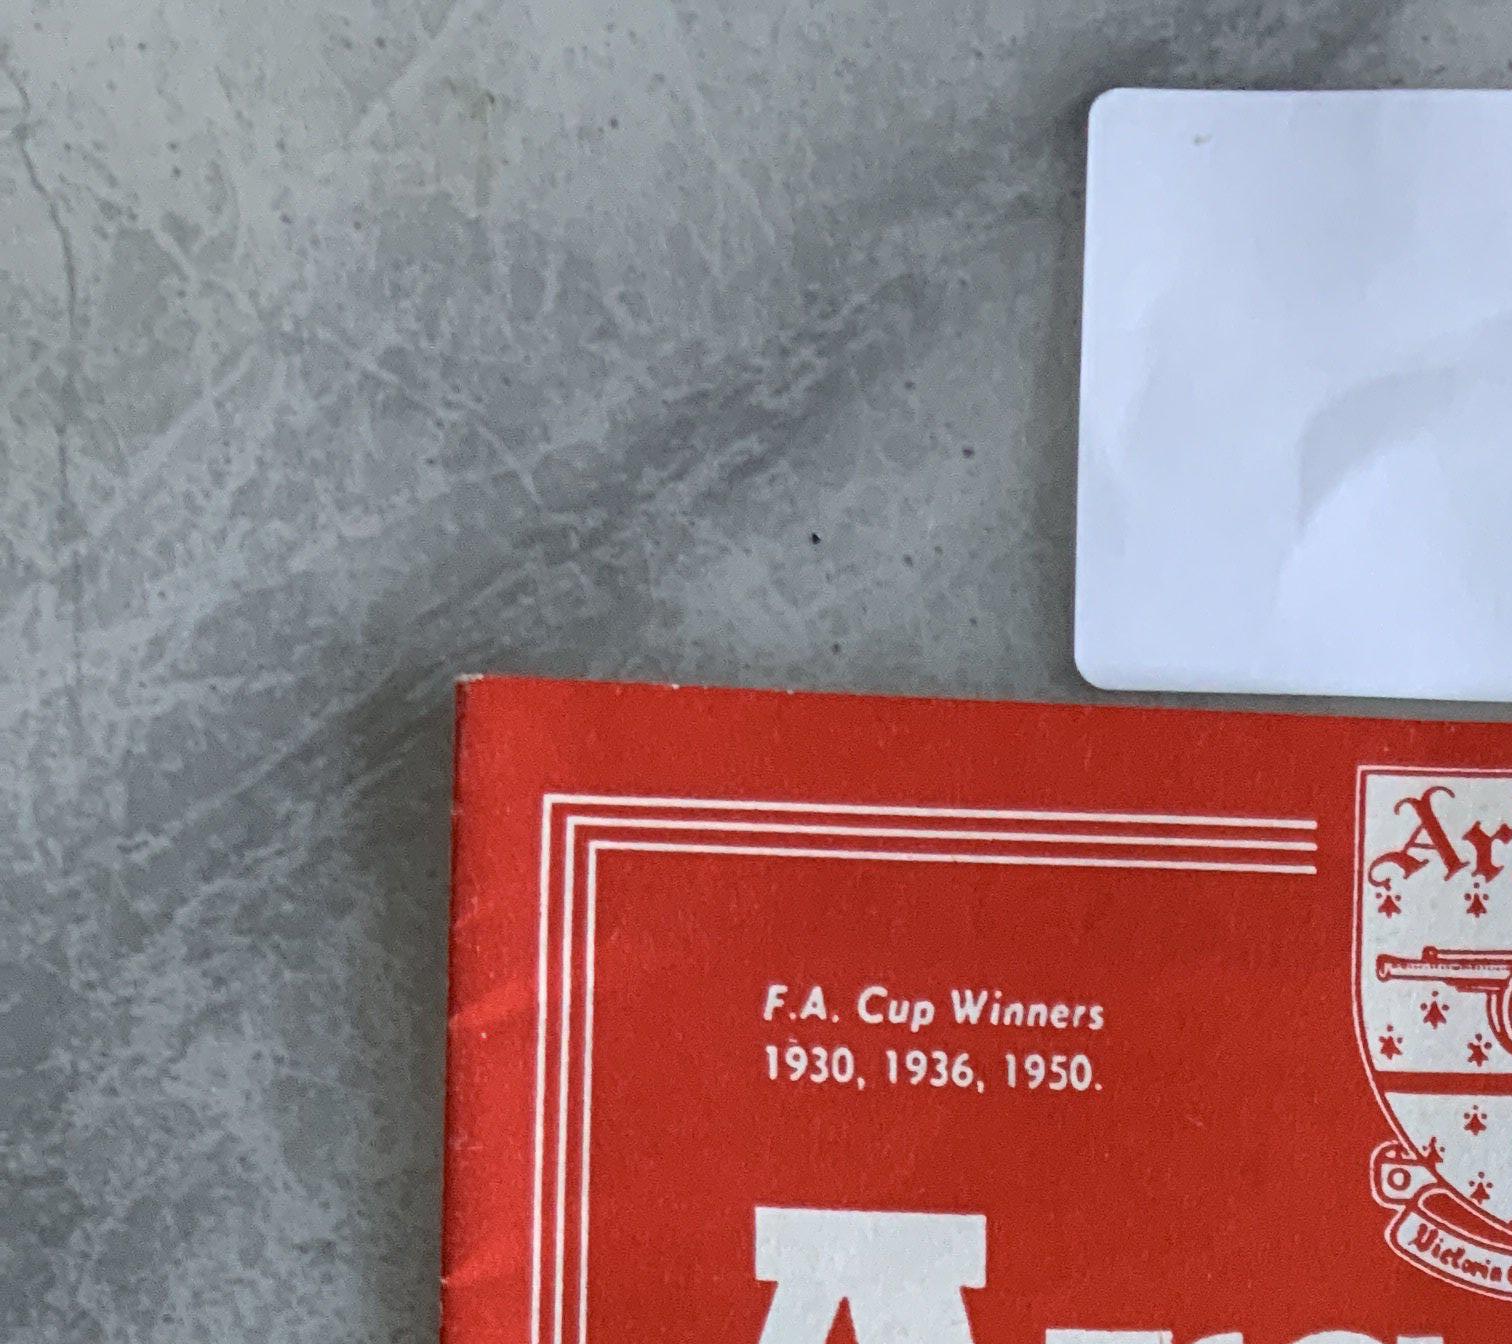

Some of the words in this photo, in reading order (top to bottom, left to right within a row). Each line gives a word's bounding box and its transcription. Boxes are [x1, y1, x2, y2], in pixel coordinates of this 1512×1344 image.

[763, 984, 840, 1023] F.A.
[857, 985, 935, 1033] Cup
[950, 989, 1104, 1031] Winners
[765, 1044, 866, 1090] 1930,
[885, 1049, 985, 1094] 1936,
[1005, 1053, 1103, 1091] 1950.
